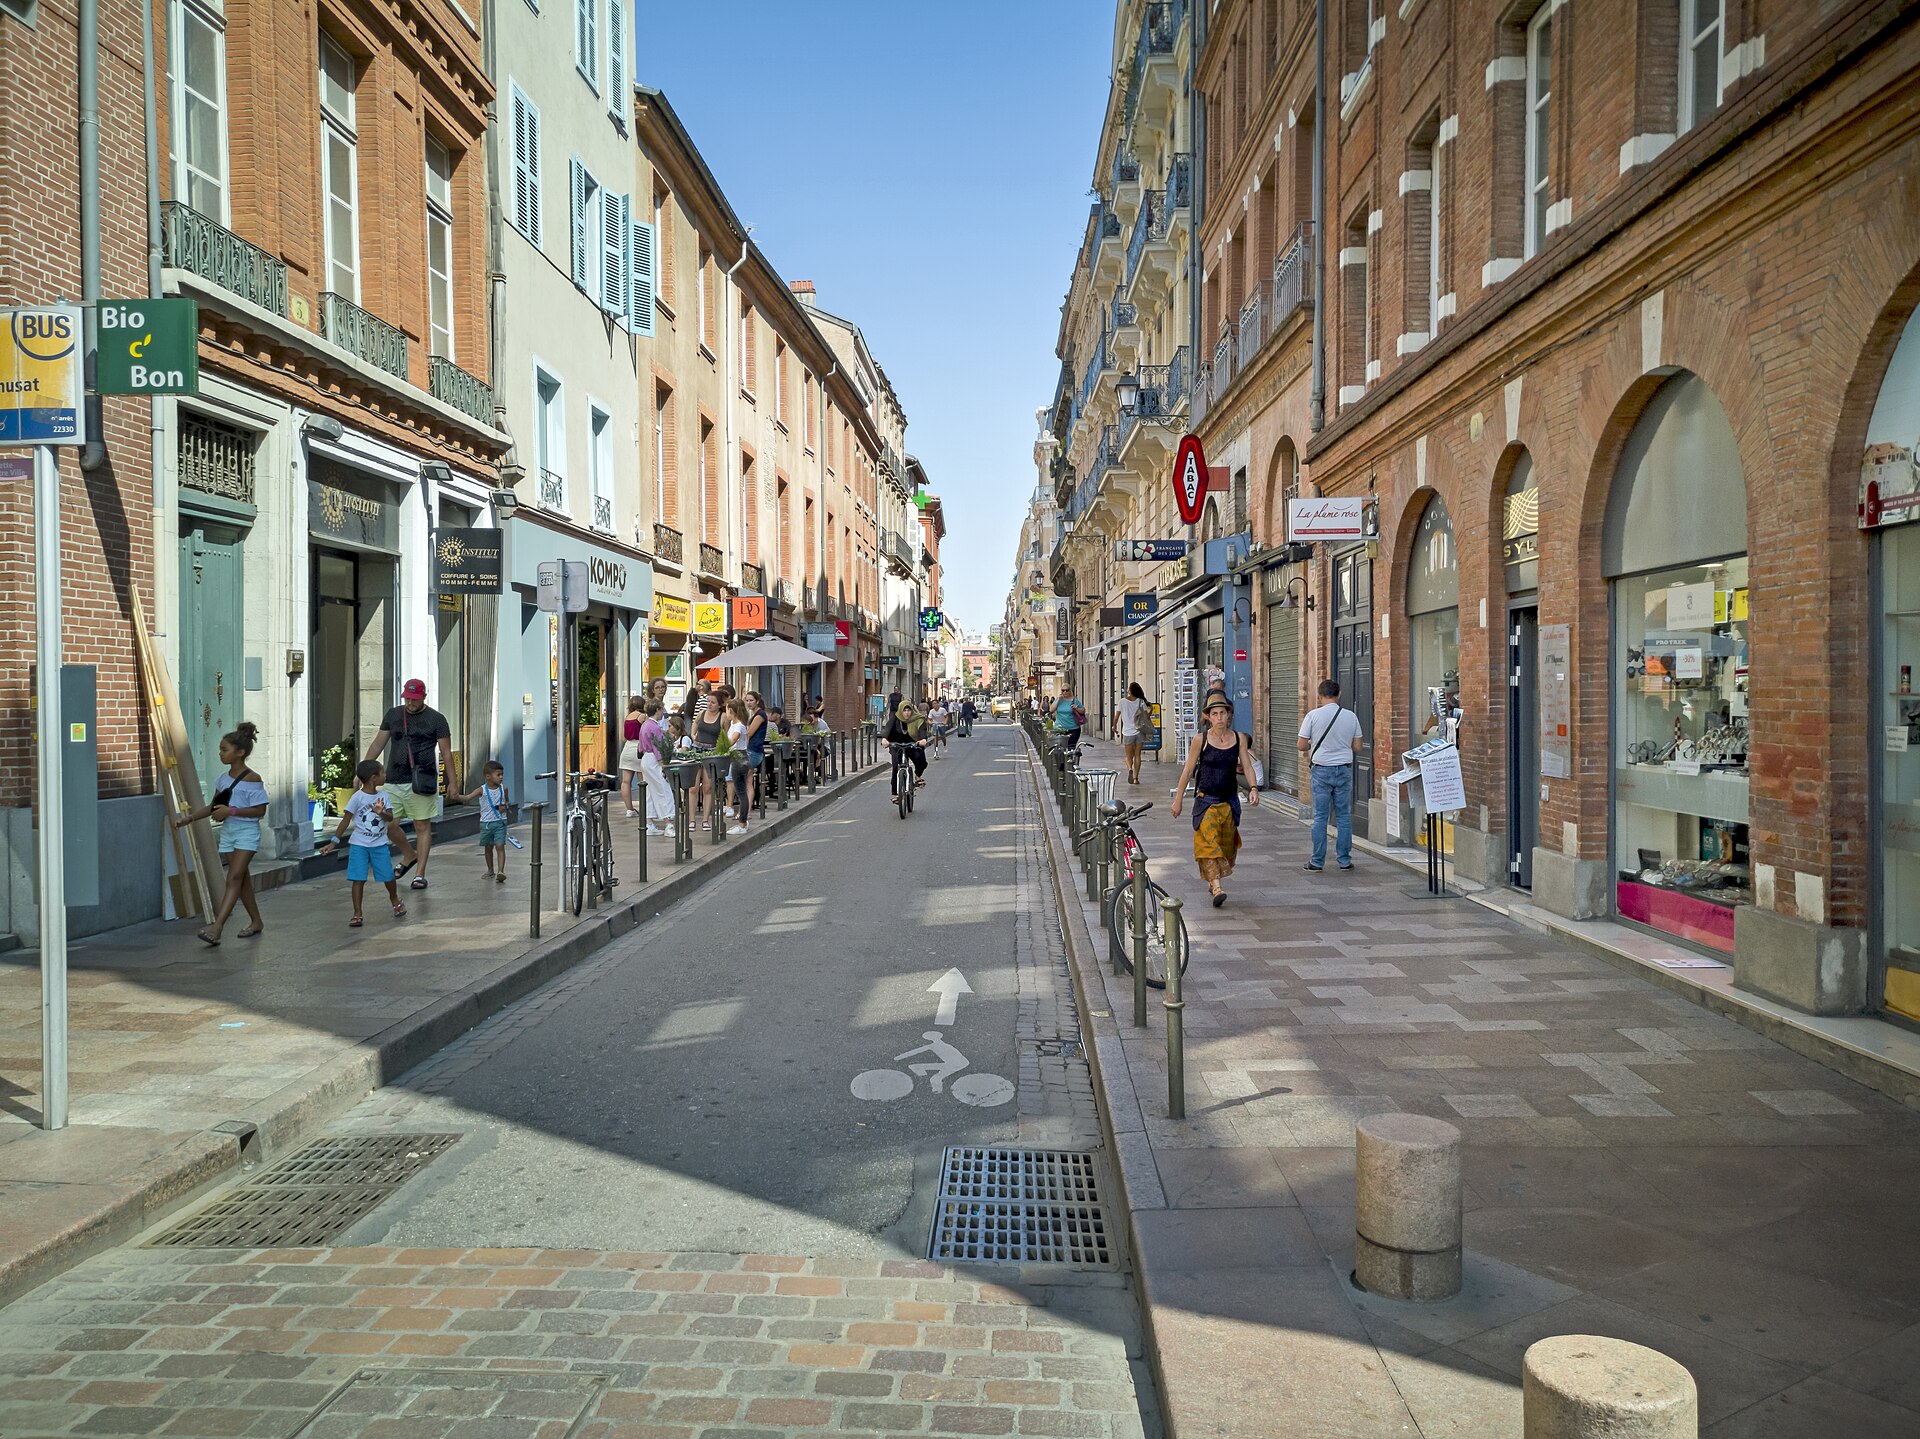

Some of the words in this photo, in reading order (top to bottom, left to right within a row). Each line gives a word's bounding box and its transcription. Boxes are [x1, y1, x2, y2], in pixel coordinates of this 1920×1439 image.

[22, 315, 71, 339] BUS
[102, 306, 145, 329] Bio
[131, 365, 184, 388] Bon
[53, 425, 75, 433] 22330
[1187, 457, 1195, 499] TABAC
[1295, 507, 1312, 519] La
[1306, 503, 1339, 528] plume
[1341, 511, 1360, 519] rose
[461, 548, 499, 556] INSTITUT
[1133, 602, 1148, 610] OR
